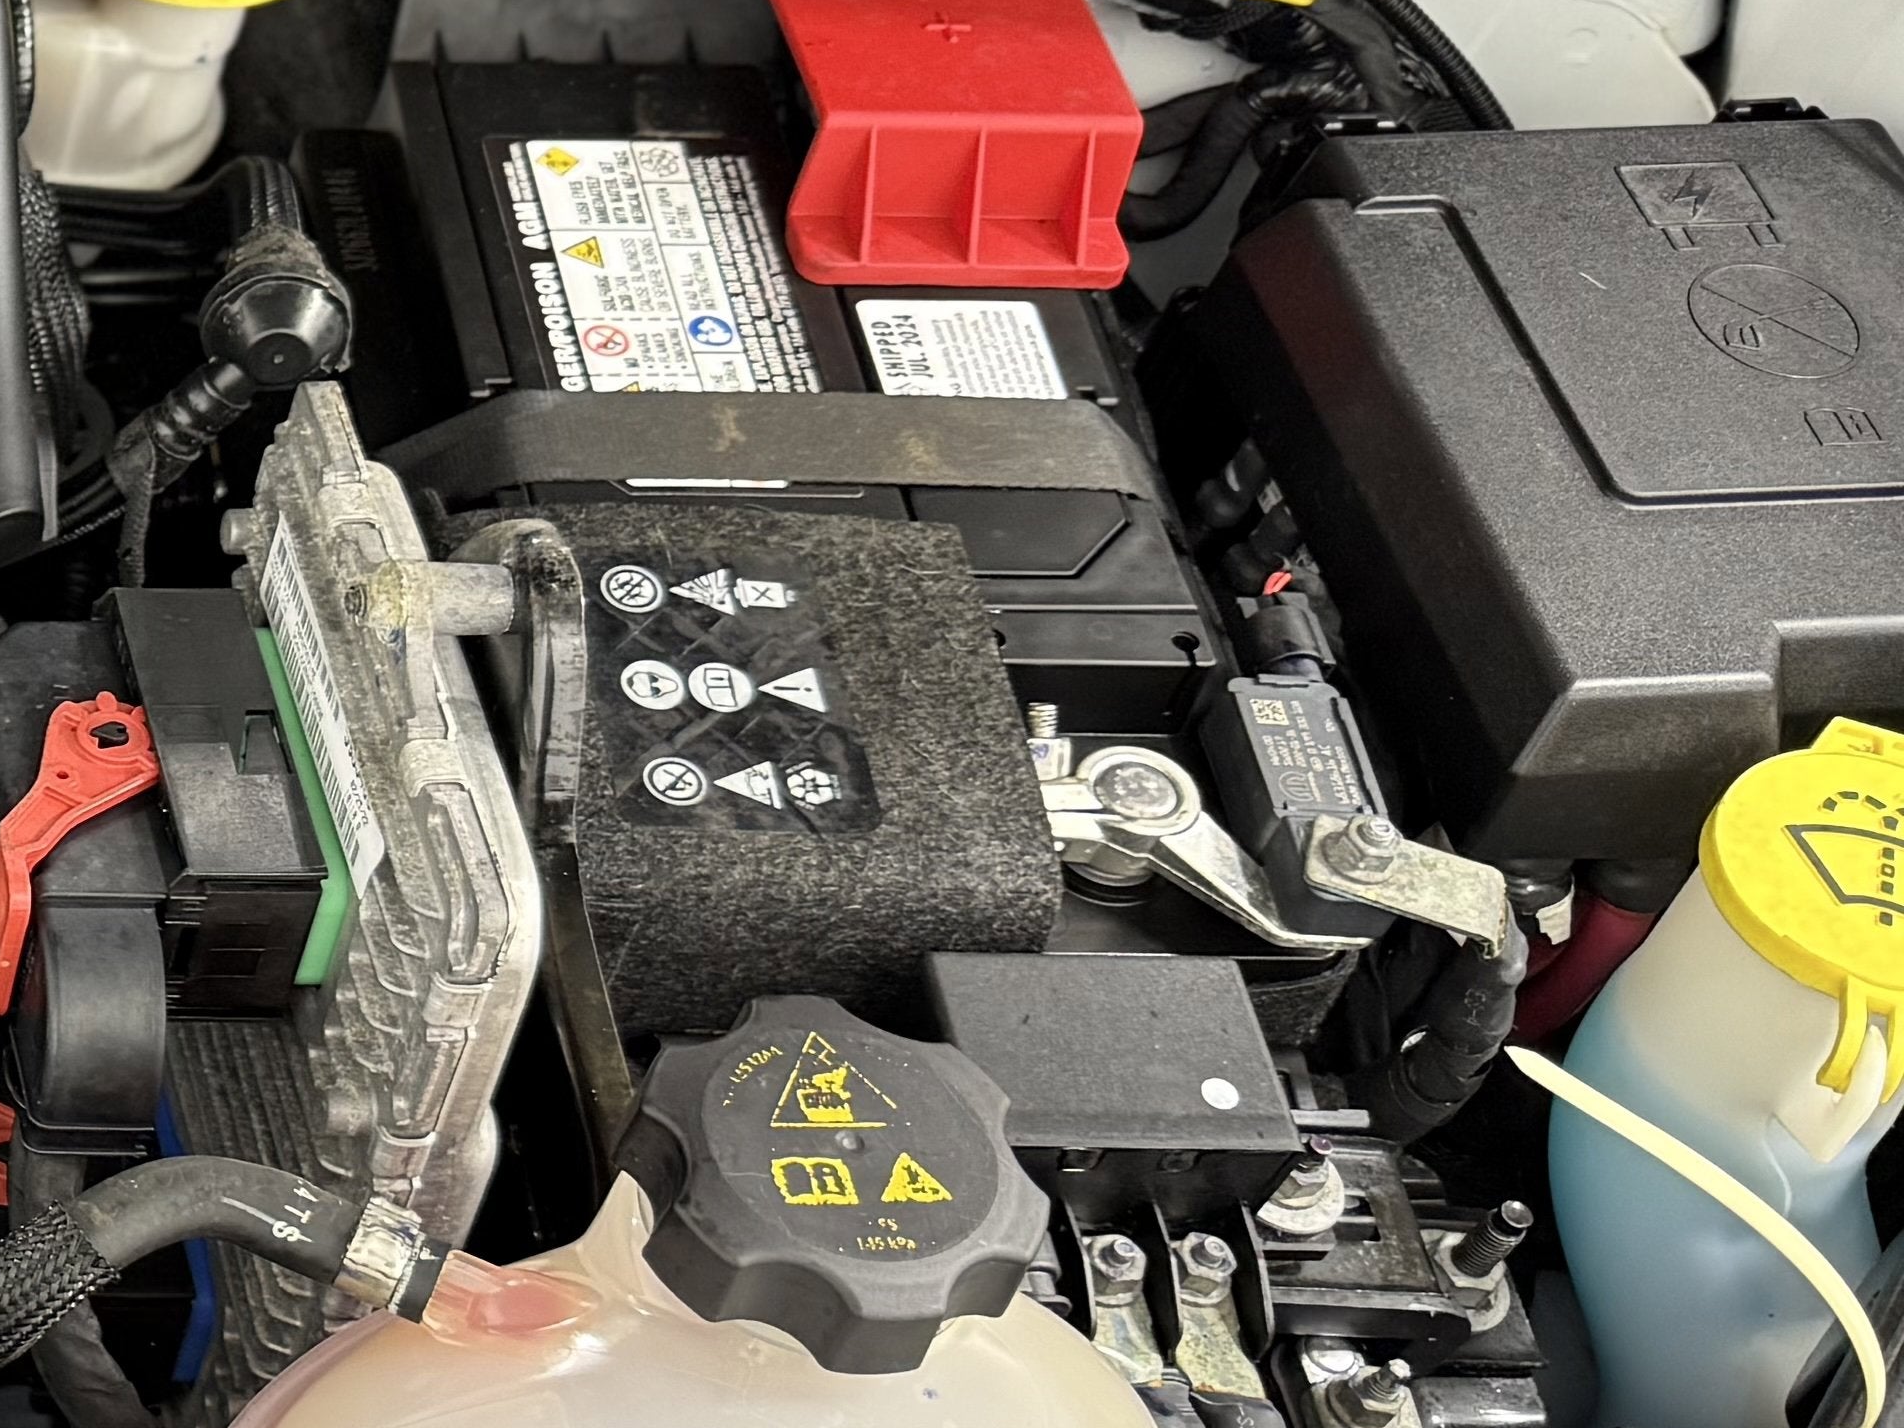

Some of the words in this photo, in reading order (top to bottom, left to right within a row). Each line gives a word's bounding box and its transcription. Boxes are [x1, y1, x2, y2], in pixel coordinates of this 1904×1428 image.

[514, 202, 550, 249] AGM
[869, 321, 908, 376] SHIPPED
[890, 314, 923, 346] 2024
